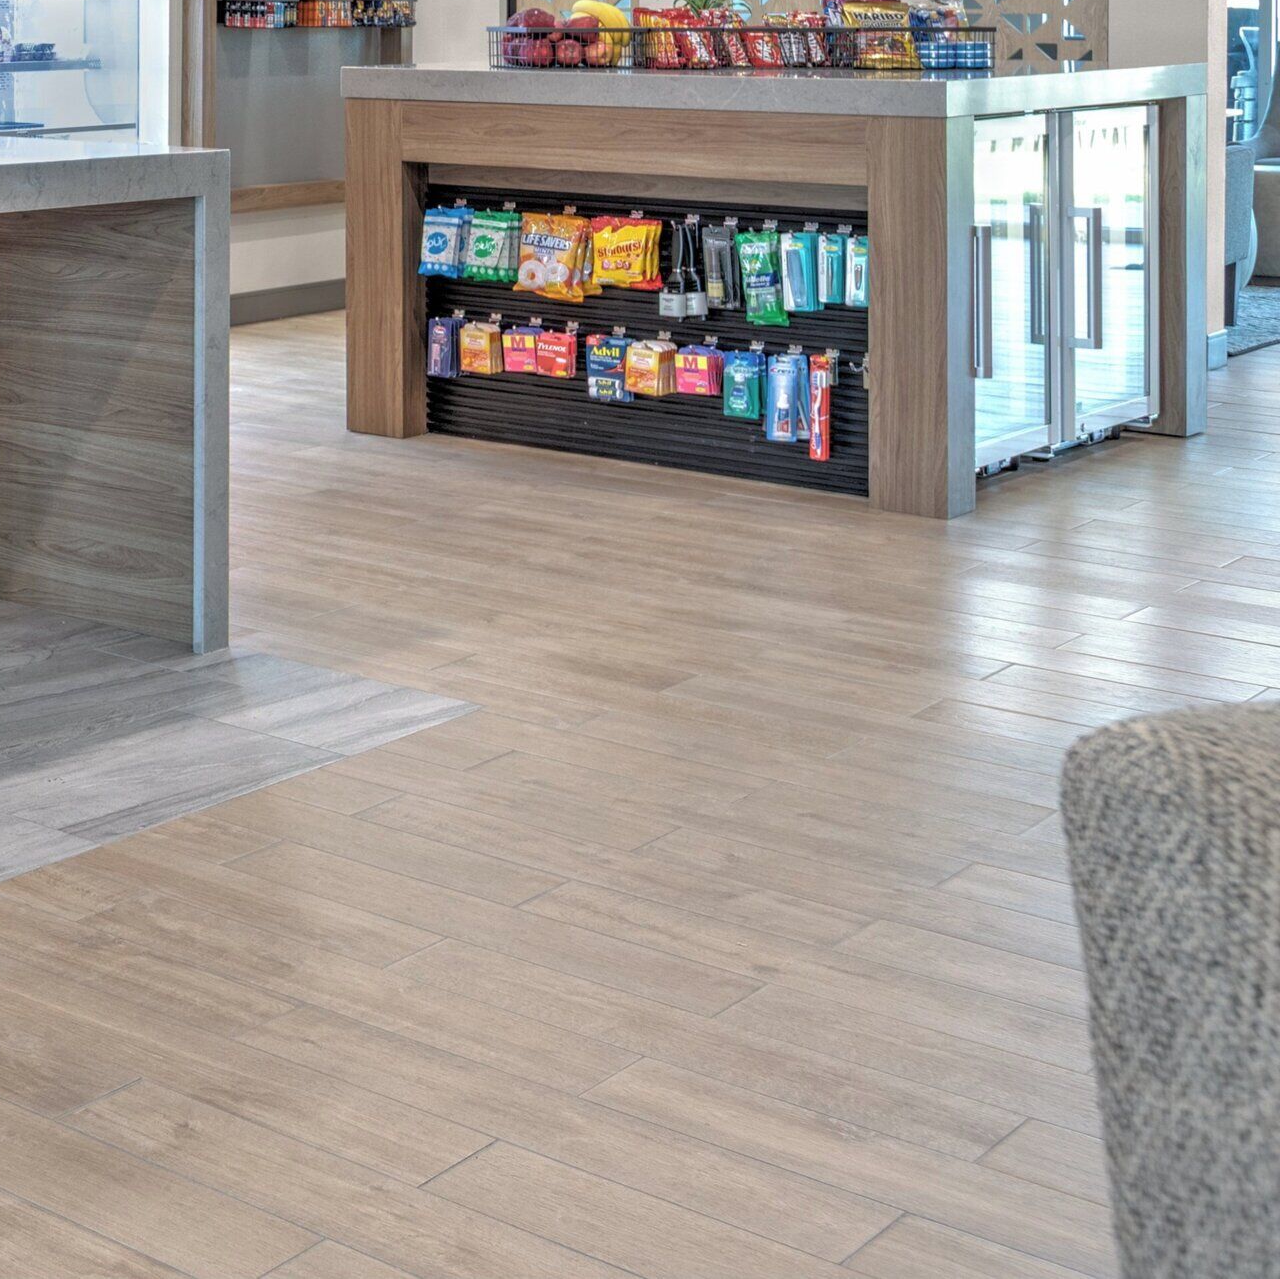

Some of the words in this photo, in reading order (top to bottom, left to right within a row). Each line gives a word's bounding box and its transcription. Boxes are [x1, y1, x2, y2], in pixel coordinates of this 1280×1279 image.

[852, 11, 905, 21] HARIBO
[537, 341, 567, 352] TYLENOL
[591, 345, 620, 357] Advil
